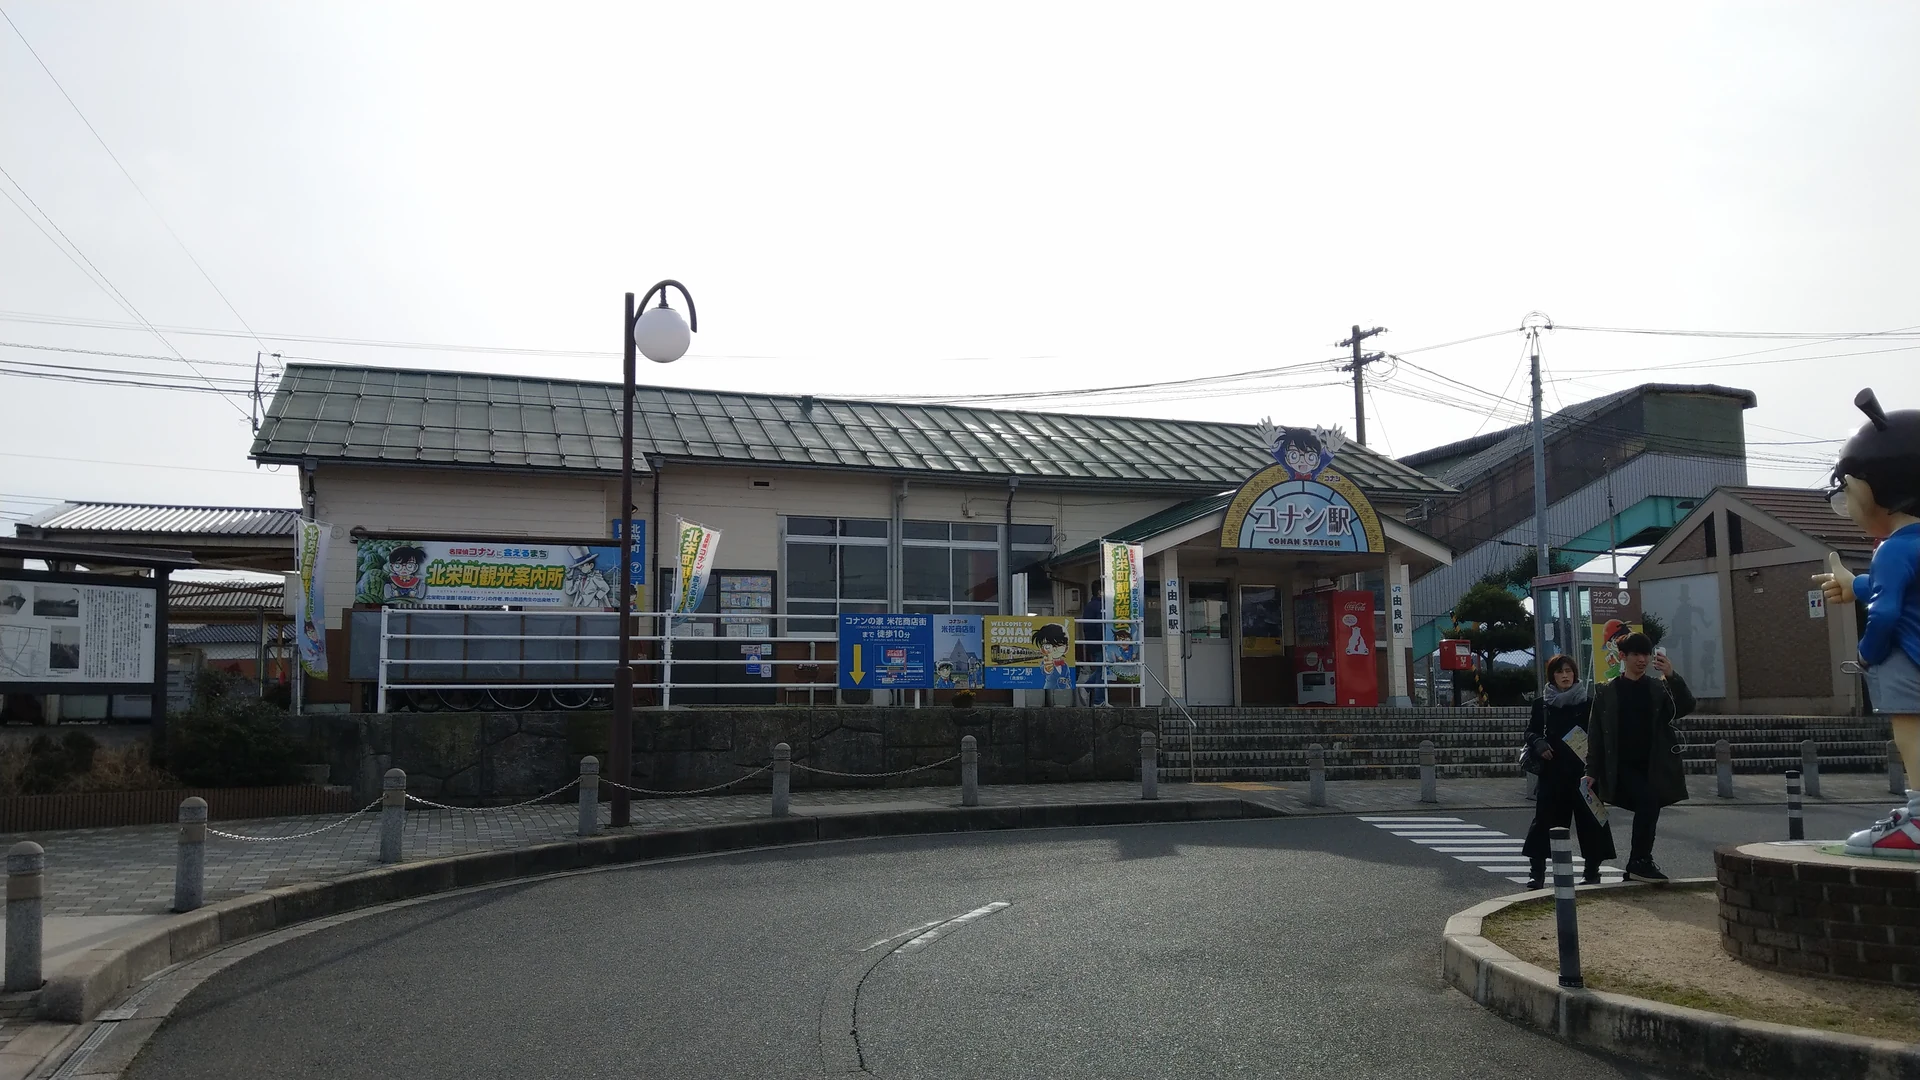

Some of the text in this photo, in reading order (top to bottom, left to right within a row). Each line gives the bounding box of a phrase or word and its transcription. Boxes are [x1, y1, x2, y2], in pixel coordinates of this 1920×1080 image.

[1255, 503, 1351, 535] コナン駅
[1268, 538, 1341, 547] CONAN STATION
[427, 563, 564, 589] 北栄町観光案内所
[1167, 589, 1179, 630] 由良駅
[1392, 595, 1404, 634] 由良駅
[845, 616, 927, 626] コナンの家 米花商店街
[876, 630, 911, 639] 徒歩10分
[990, 627, 1033, 636] CONAN
[1002, 668, 1033, 676] コナン駅
